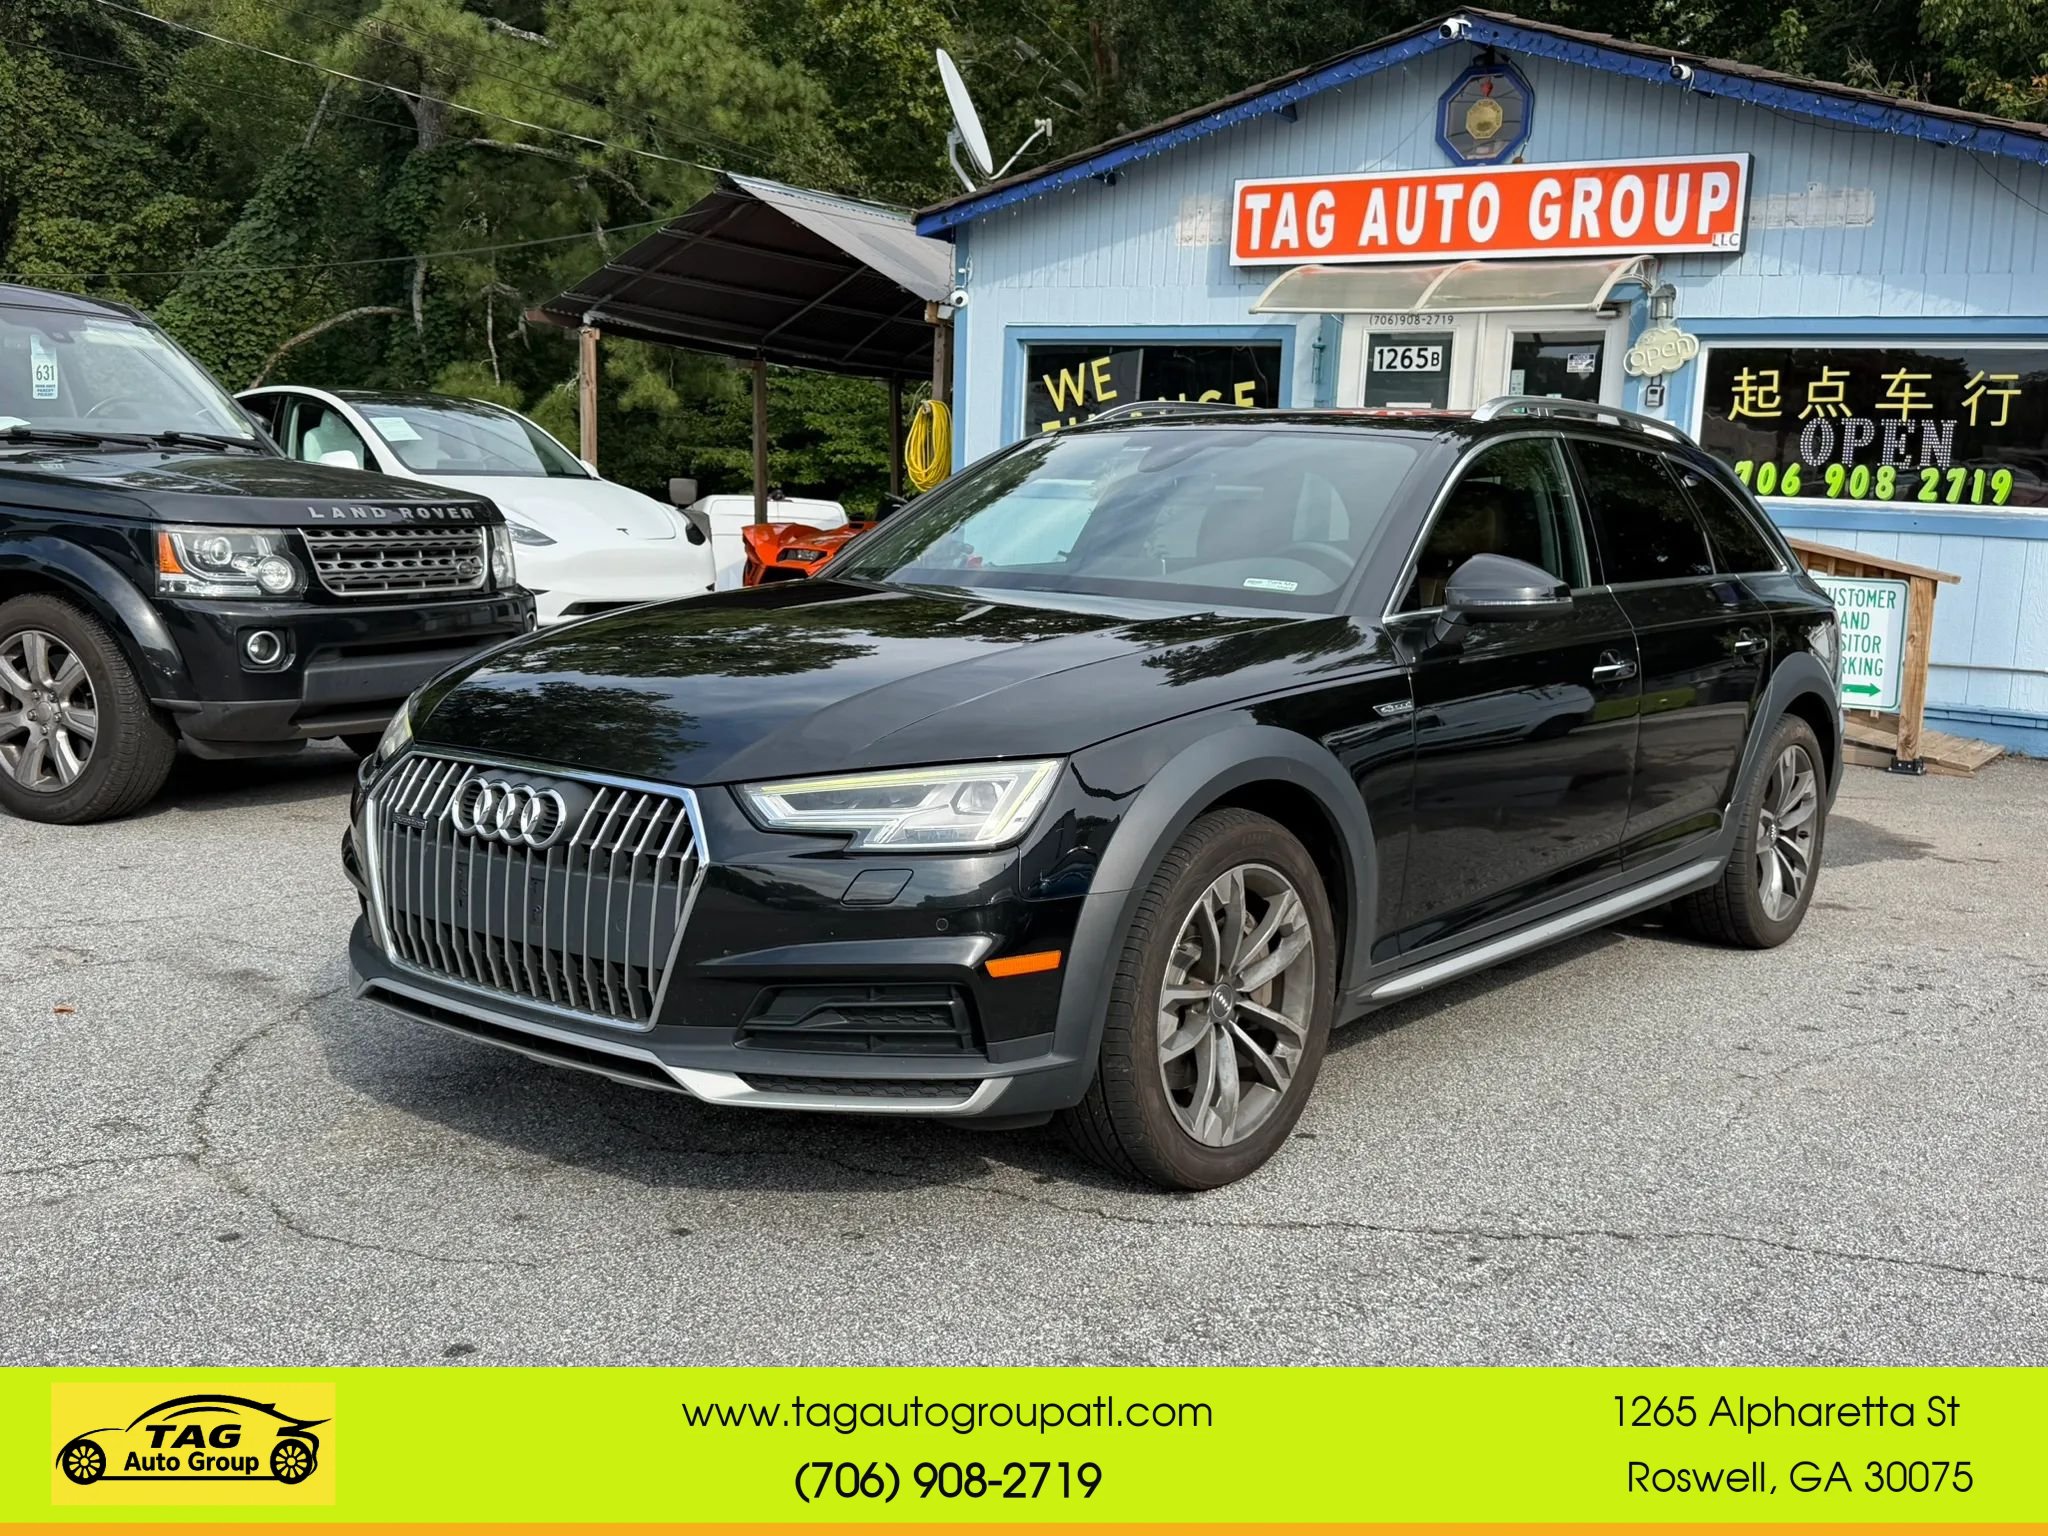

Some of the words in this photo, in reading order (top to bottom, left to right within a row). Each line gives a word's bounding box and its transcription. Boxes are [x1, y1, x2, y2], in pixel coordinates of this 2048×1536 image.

[1245, 189, 1336, 250] TAG
[1357, 180, 1500, 247] AUTO
[1528, 170, 1732, 242] GROUP
[1712, 232, 1740, 247] LLC
[1368, 314, 1455, 326] (706)908-2719
[1630, 337, 1691, 367] open
[36, 364, 55, 381] 631
[1042, 356, 1118, 413] WE
[1728, 366, 2021, 427] 起点车行
[1799, 416, 1959, 472] OPEN
[1735, 460, 1802, 497] 706
[1824, 463, 1896, 501] 908
[1918, 467, 2013, 506] 2719
[307, 506, 387, 519] LAND
[399, 506, 476, 519] ROVER
[1823, 587, 1897, 609] USTOMER
[1840, 611, 1870, 630] AND
[1841, 633, 1882, 654] SITOR
